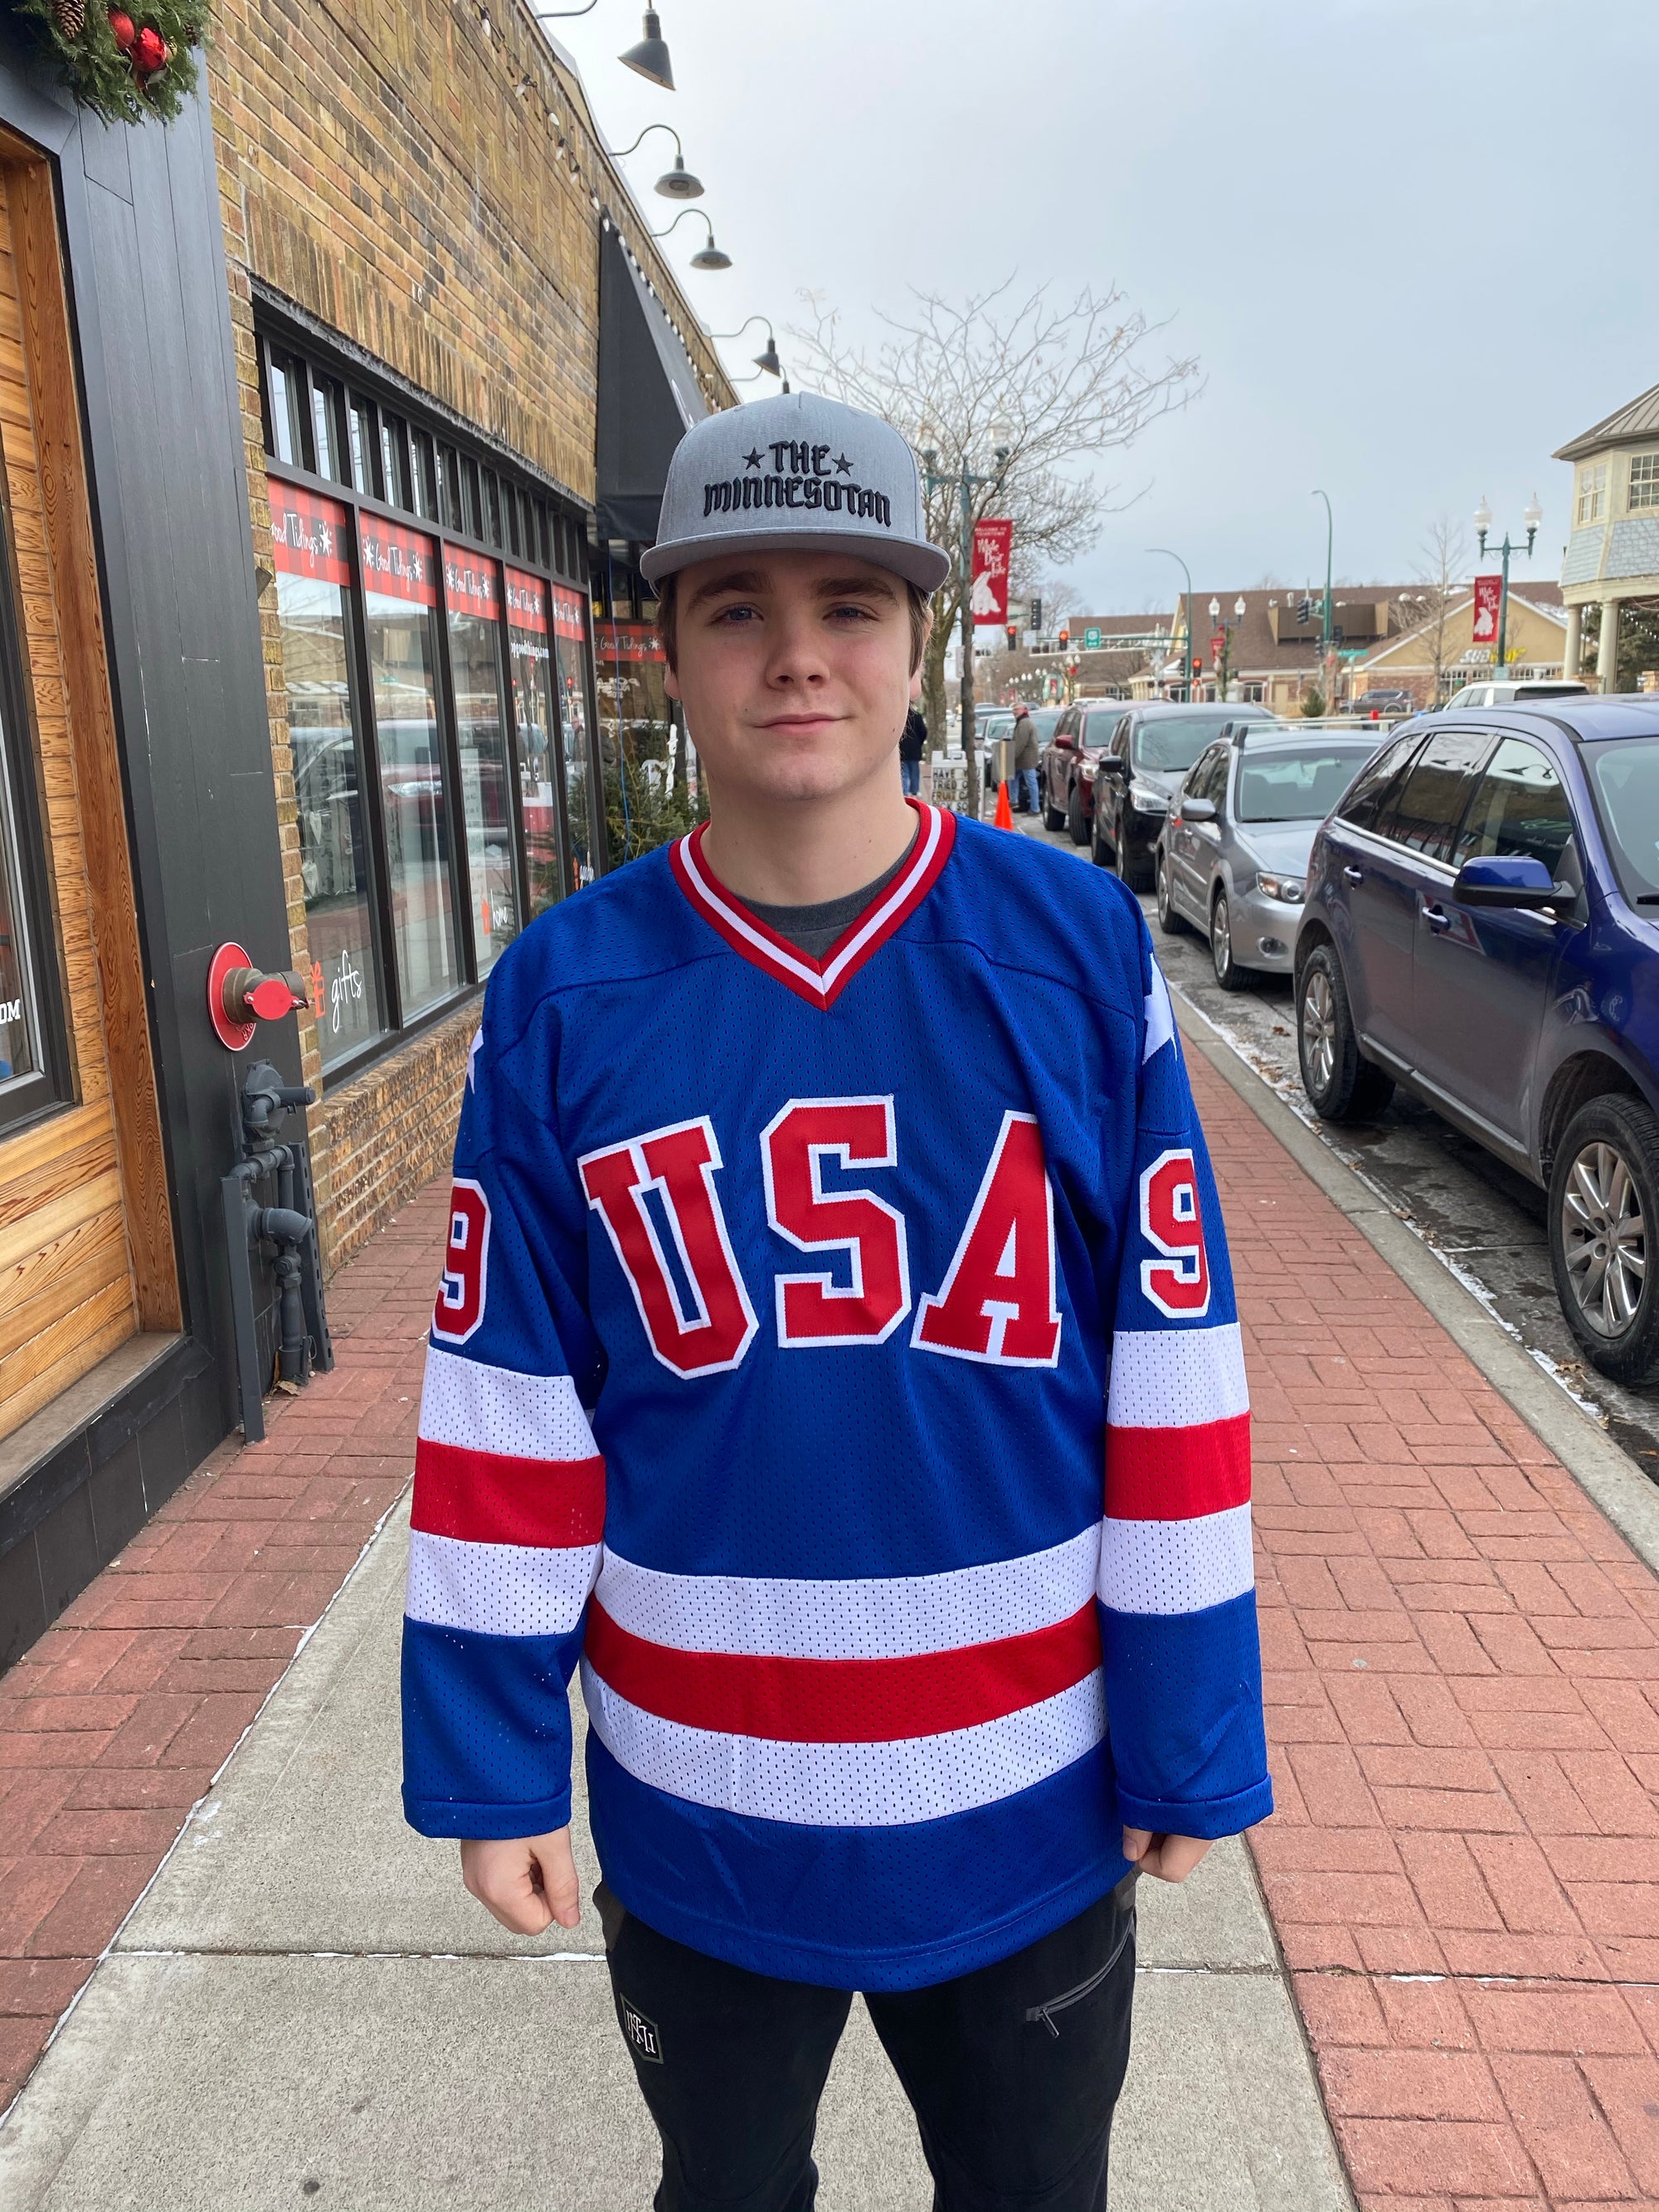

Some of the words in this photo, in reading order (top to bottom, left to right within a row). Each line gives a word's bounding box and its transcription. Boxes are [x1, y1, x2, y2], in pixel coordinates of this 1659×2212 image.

[768, 440, 832, 475] THE
[703, 474, 892, 527] MINNESOTAN
[270, 513, 288, 547] ood
[286, 513, 319, 568] Tidings
[375, 542, 392, 576] Good
[390, 546, 413, 592] Tidings
[600, 636, 619, 650] Good
[620, 635, 648, 657] Tidings
[933, 769, 956, 778] HAVE
[331, 949, 362, 1033] gifts
[577, 1092, 1062, 1380] USA
[1139, 1148, 1211, 1319] 9
[431, 1177, 492, 1345] 9
